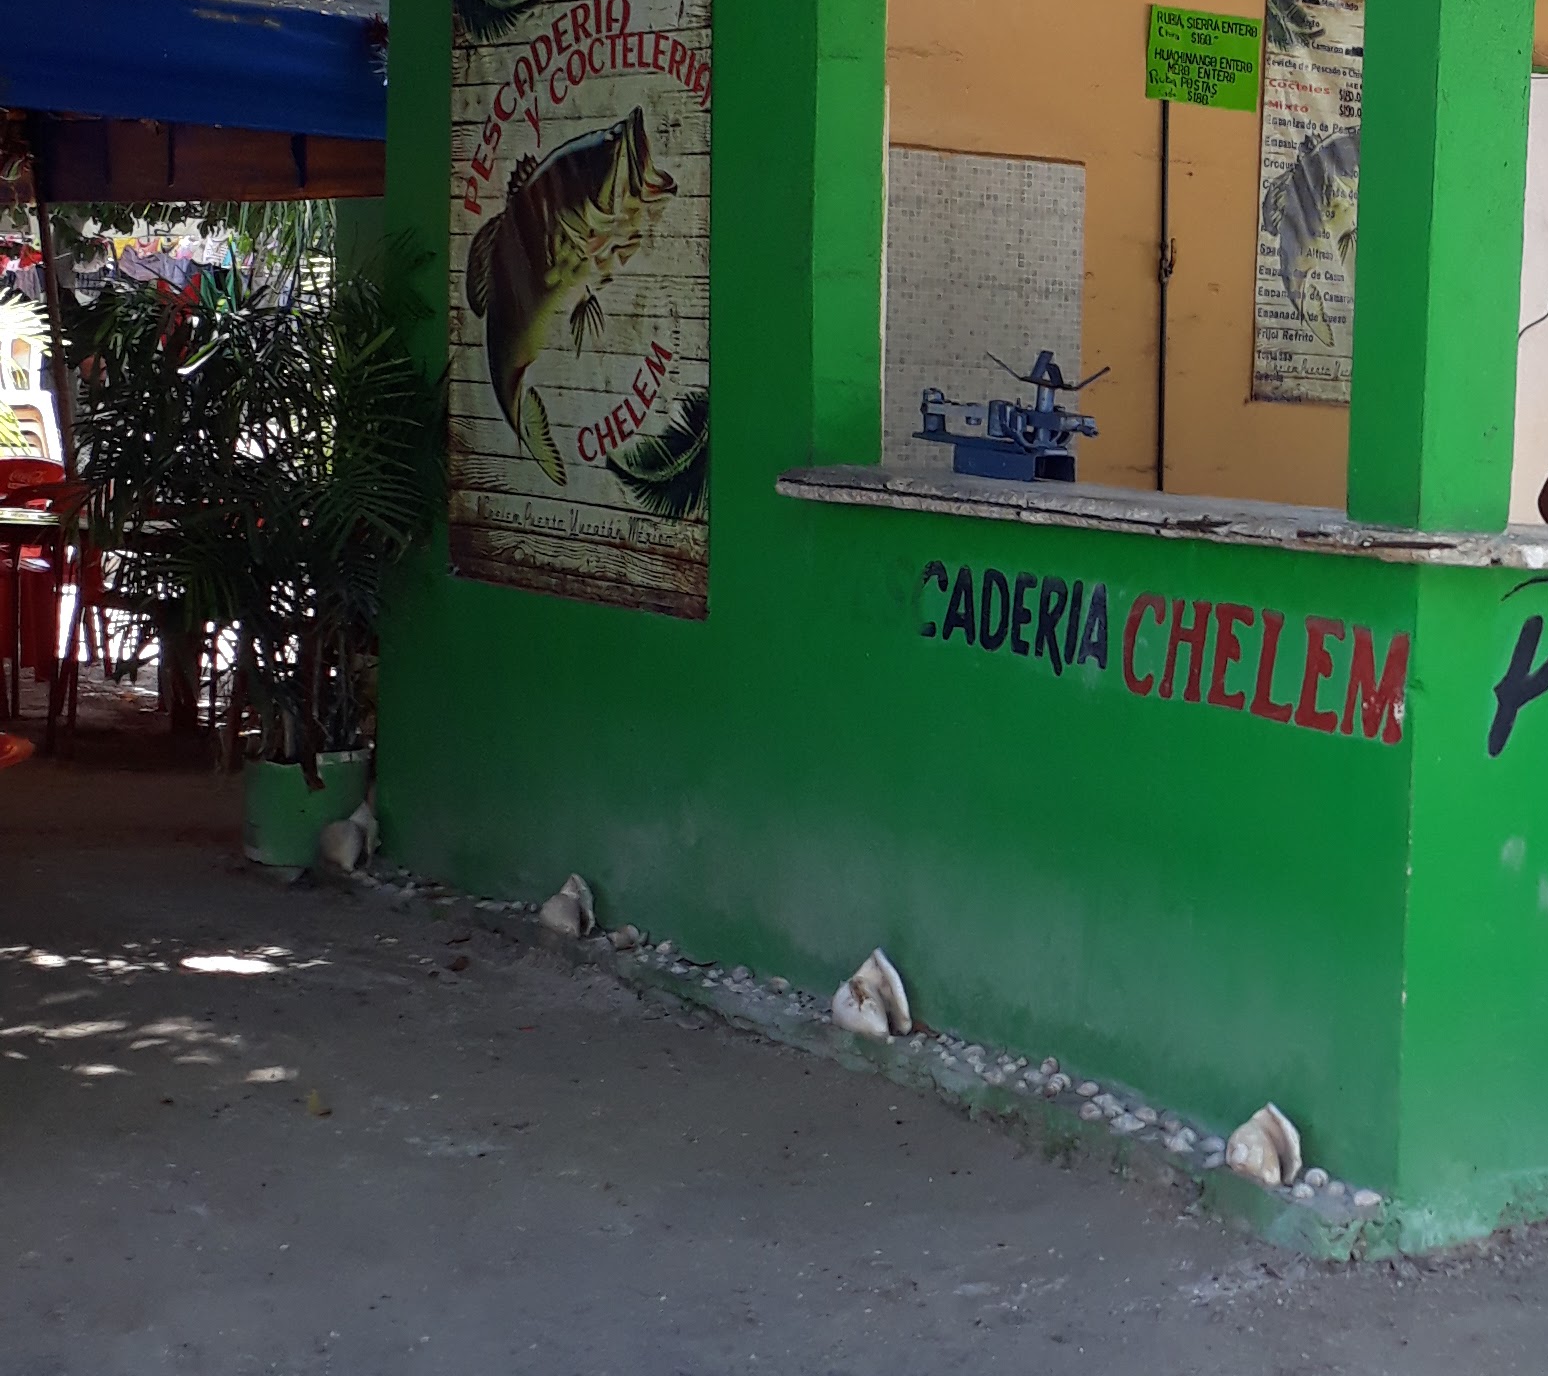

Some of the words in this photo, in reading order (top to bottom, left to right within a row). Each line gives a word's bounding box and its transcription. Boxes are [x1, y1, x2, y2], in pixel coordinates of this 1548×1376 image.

[549, 30, 712, 108] COCTELERIA
[1187, 16, 1220, 32] SIERRA
[577, 340, 673, 463] CHELEM
[1122, 593, 1410, 745] CHELEM
